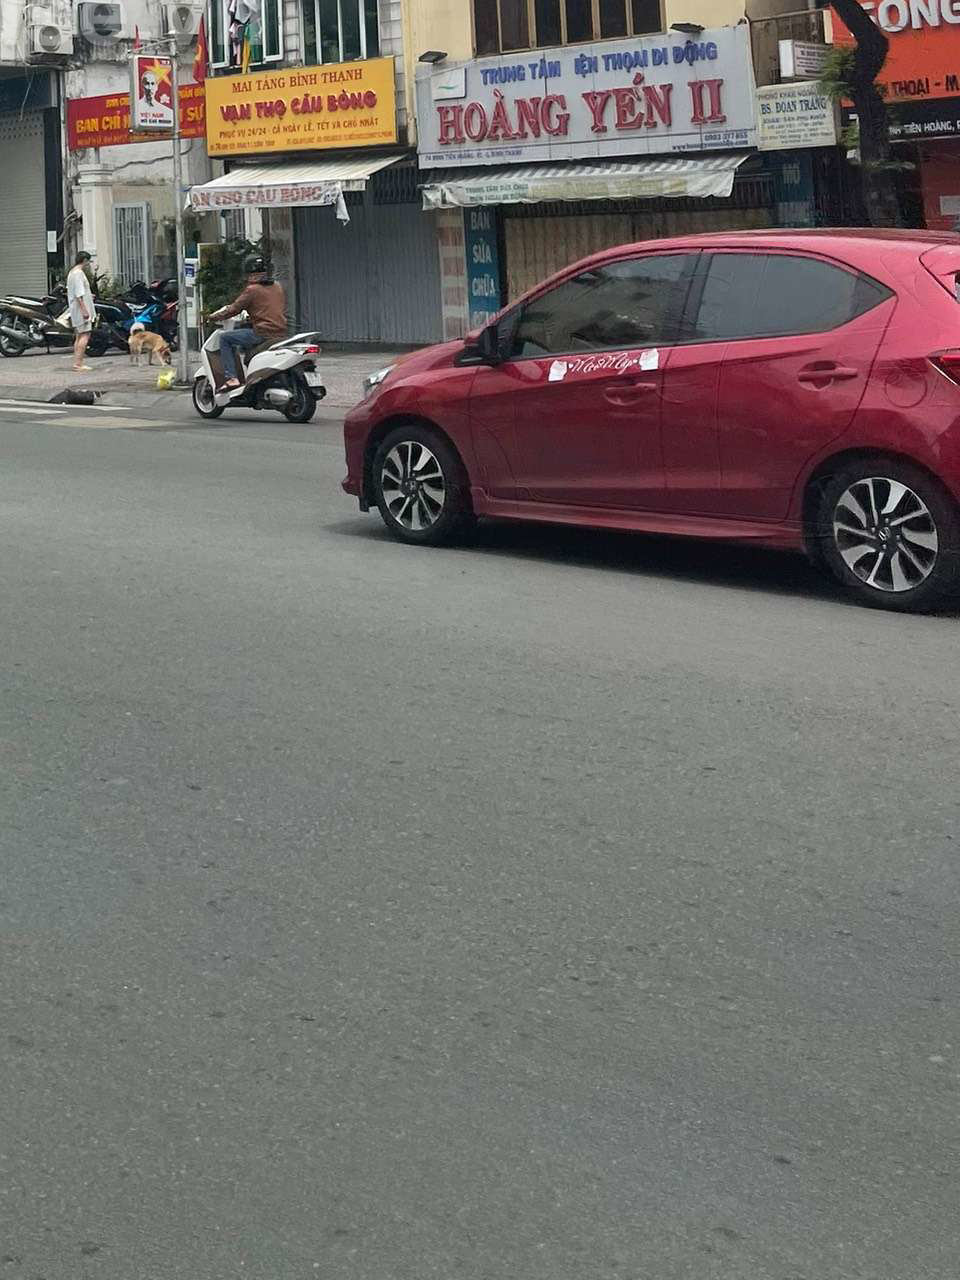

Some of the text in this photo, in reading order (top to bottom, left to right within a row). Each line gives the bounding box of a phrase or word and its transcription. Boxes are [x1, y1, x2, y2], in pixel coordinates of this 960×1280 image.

[480, 65, 525, 86] TRUNG
[528, 56, 560, 80] TÂM
[602, 49, 648, 73] THOẠI
[651, 47, 668, 66] DI
[672, 40, 718, 66] ĐỘNG
[232, 81, 252, 93] MAI
[289, 71, 317, 87] BÌNH
[322, 68, 362, 85] THẠNH
[892, 77, 930, 97] THOẠI
[220, 104, 251, 125] VẠN
[255, 100, 287, 120] THỌ
[437, 89, 570, 145] HOÀNG
[582, 72, 673, 133] YẾN
[76, 118, 99, 133] BAN
[102, 111, 120, 130] CHỈ
[473, 238, 493, 264] SỬA
[472, 274, 496, 297] CHỮA
